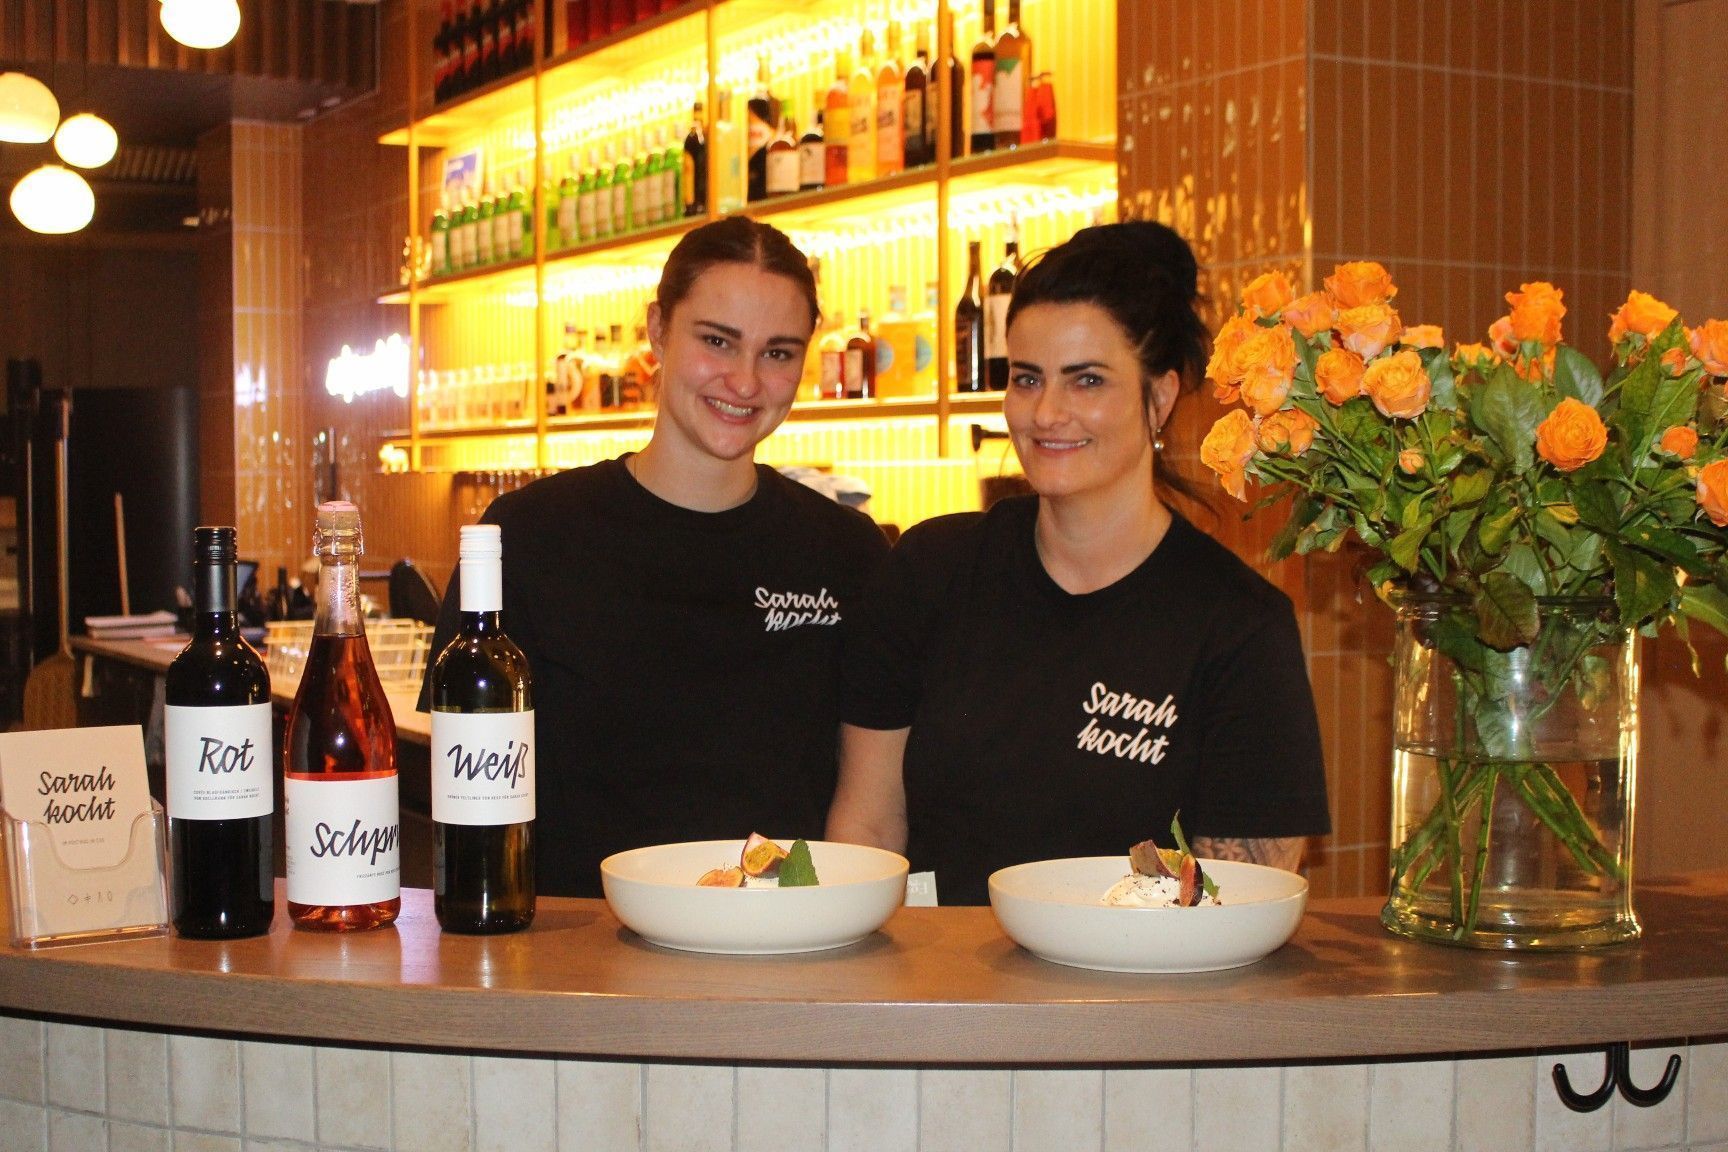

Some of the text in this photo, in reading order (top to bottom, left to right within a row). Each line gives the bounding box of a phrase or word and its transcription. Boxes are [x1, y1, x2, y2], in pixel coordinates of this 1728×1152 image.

[754, 586, 839, 610] Sarah
[1082, 681, 1179, 728] Sarah
[198, 736, 255, 775] Rot
[1077, 717, 1170, 765] kocht
[37, 765, 116, 796] Sarah
[446, 740, 529, 789] Weiß
[43, 796, 116, 824] kocht
